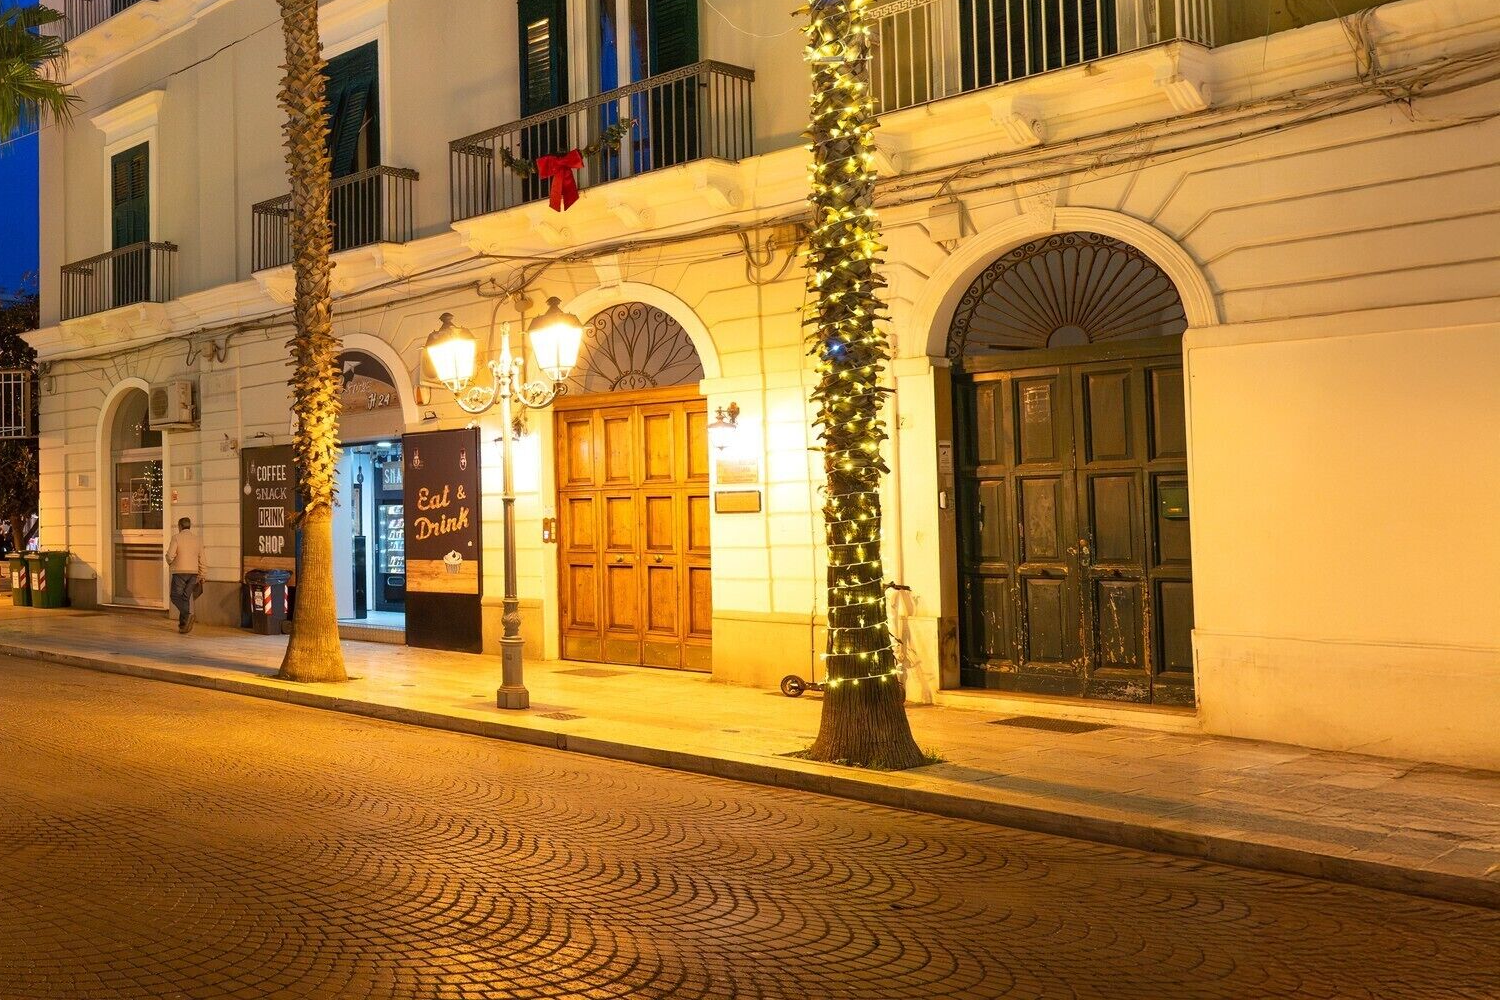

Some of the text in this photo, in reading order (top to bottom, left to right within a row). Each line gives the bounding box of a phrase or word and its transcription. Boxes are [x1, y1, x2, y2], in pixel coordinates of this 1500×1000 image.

[256, 464, 287, 482] COFFEE
[255, 487, 288, 500] SNACK
[417, 484, 467, 511] Eat &
[259, 508, 284, 527] DRINK
[414, 506, 469, 540] Drink
[258, 535, 285, 554] SHOP
